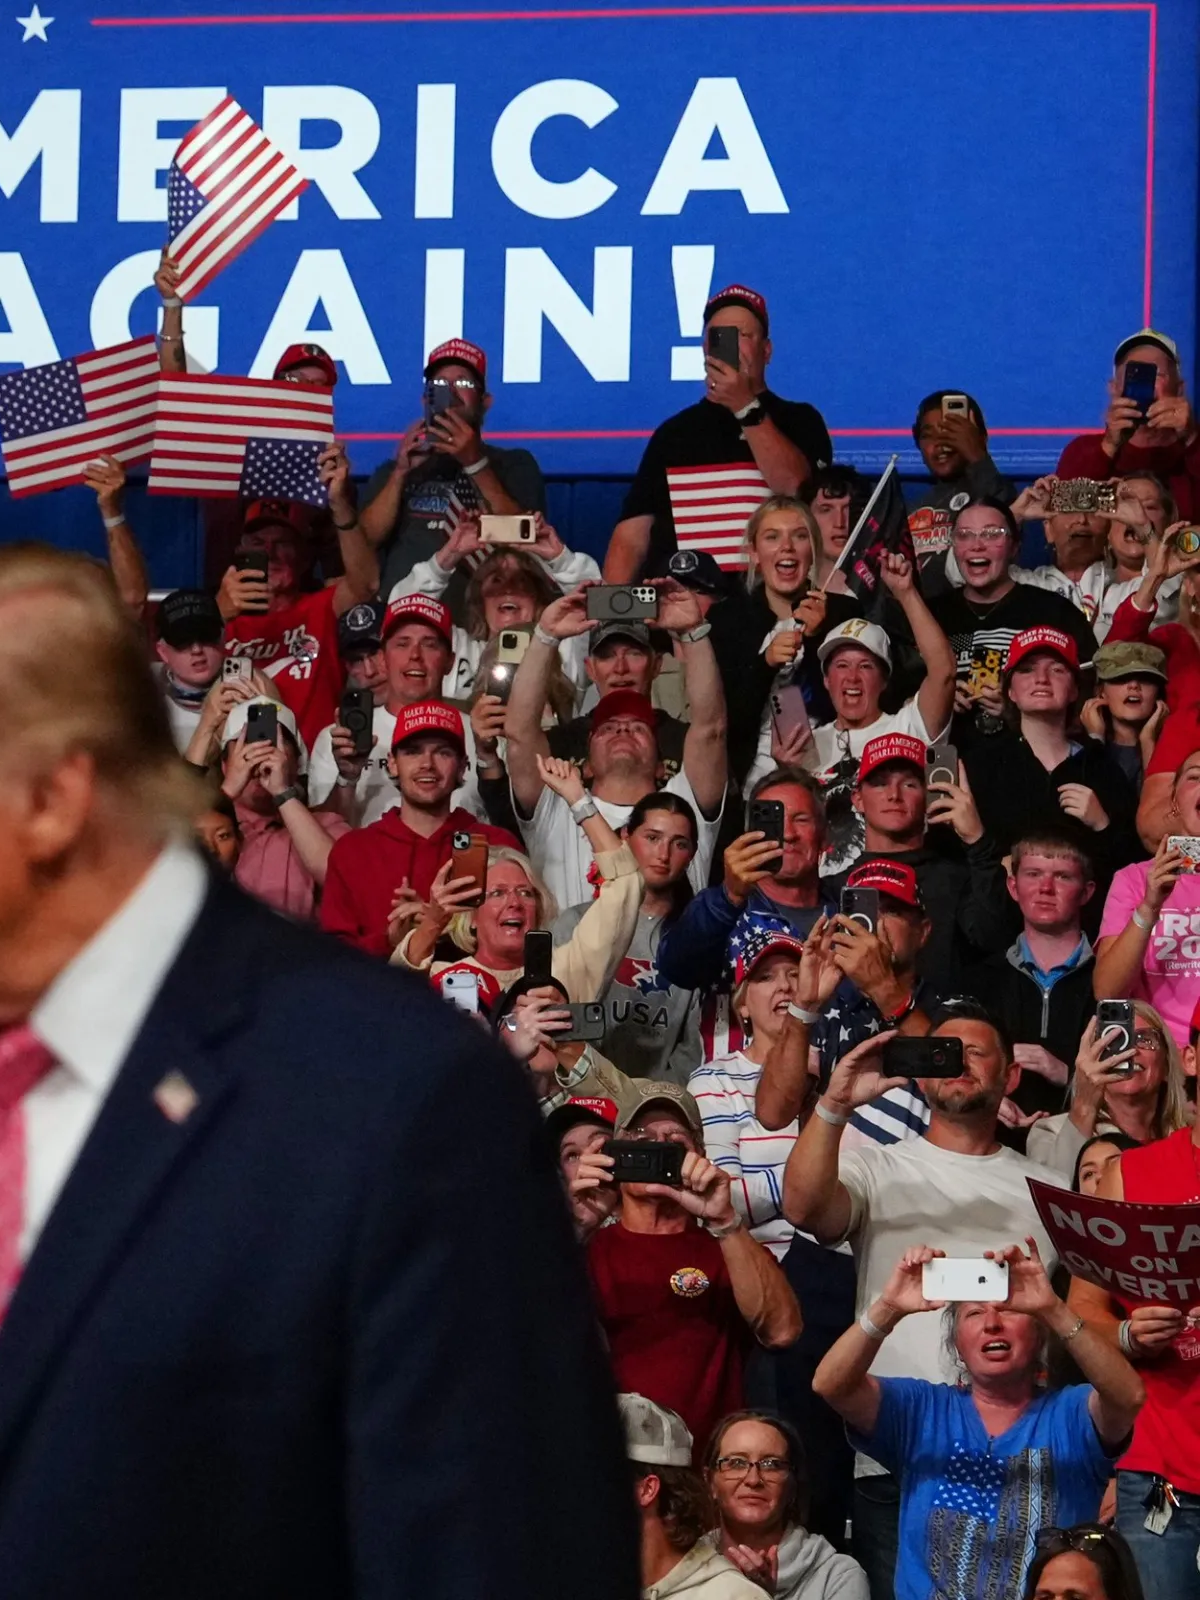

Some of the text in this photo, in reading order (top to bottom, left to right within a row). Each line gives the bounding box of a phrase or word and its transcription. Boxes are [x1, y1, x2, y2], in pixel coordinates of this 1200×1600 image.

[840, 619, 869, 638] 47
[1017, 628, 1069, 645] MAKE AMERICA
[1020, 635, 1043, 648] GREAT
[288, 662, 312, 680] 47
[404, 706, 425, 720] MAKE
[868, 739, 888, 753] MAKE
[612, 1000, 669, 1030] USA
[571, 1098, 607, 1109] MERICA
[1048, 1200, 1126, 1247] NO
[1130, 1255, 1179, 1274] ON
